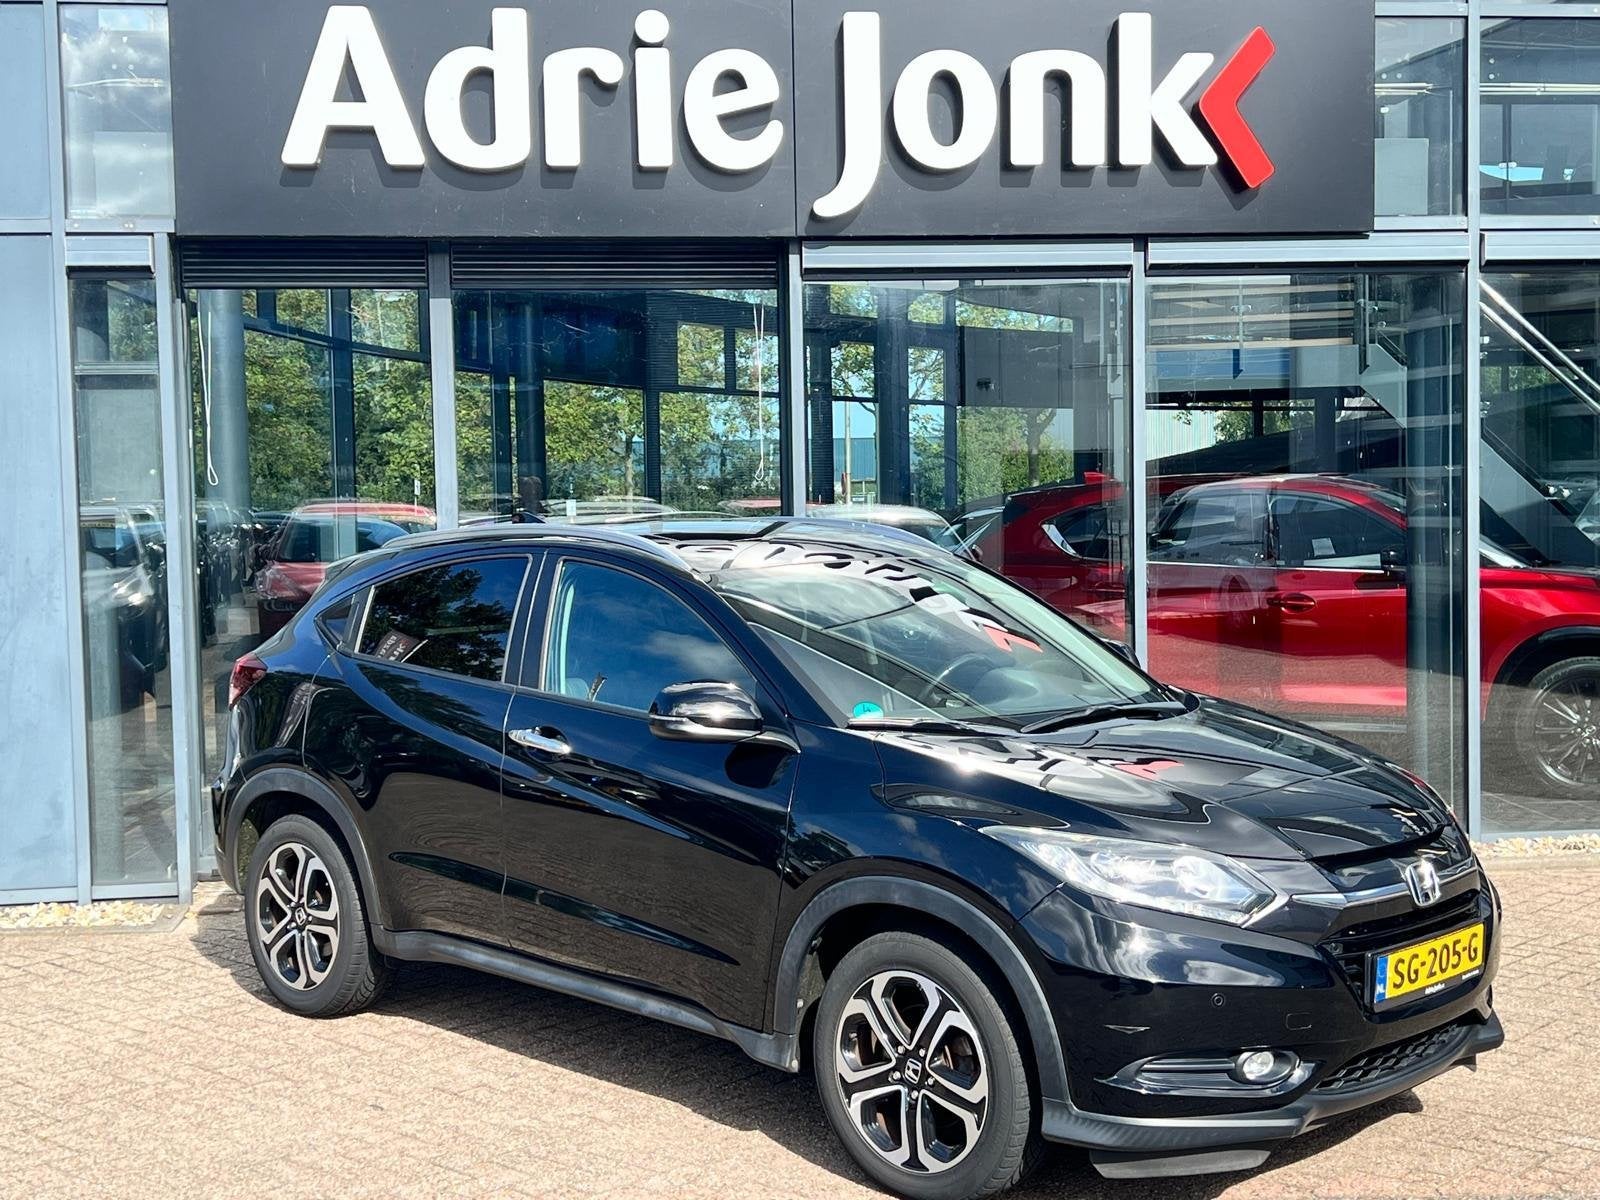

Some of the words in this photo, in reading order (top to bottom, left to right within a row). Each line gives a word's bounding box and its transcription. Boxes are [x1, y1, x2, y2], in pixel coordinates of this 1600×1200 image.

[281, 5, 784, 170] Adrie
[812, 11, 1219, 218] Jonk
[1392, 932, 1479, 990] SG-205-G
